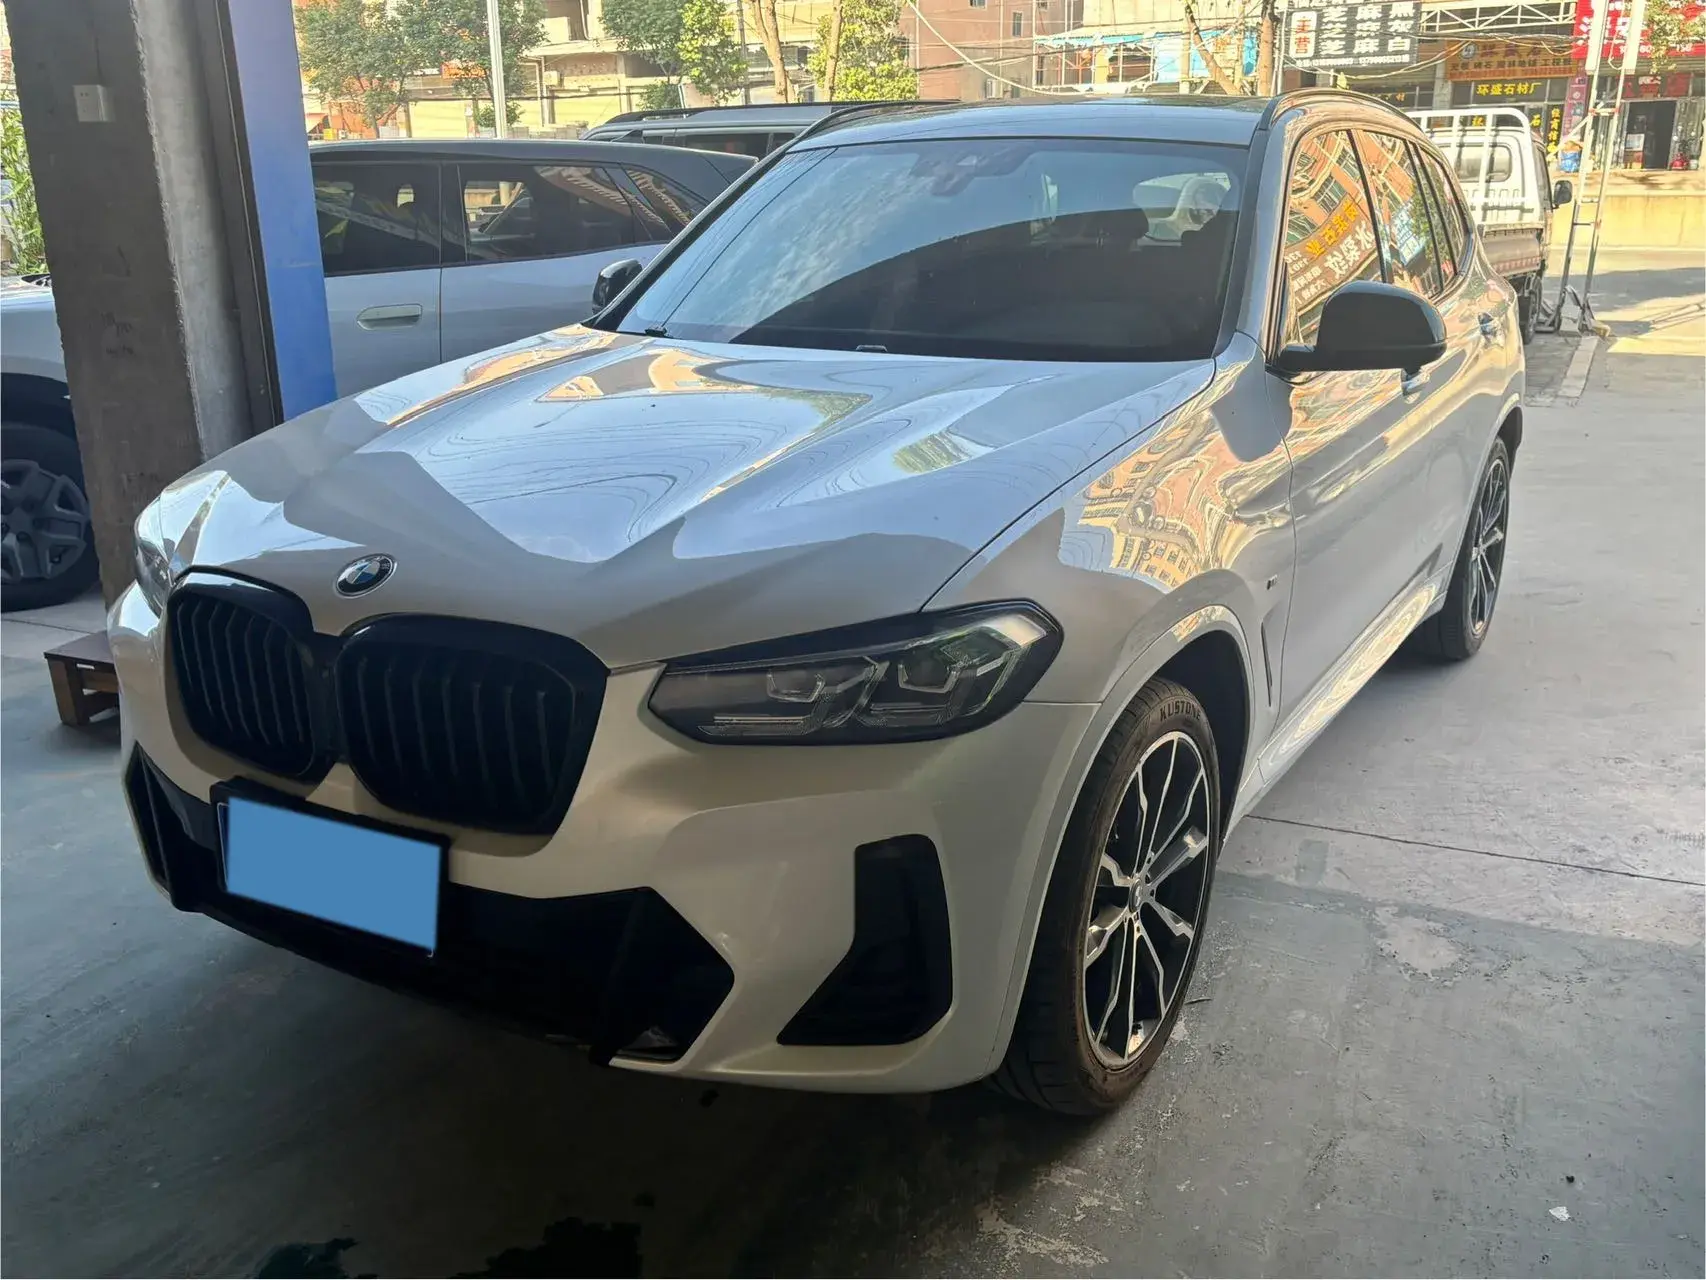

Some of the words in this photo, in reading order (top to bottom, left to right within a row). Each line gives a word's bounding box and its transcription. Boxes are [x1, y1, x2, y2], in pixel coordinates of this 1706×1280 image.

[1322, 2, 1416, 22] 芝麻黑
[1295, 16, 1310, 54] 主营
[1320, 37, 1411, 55] 芝麻白
[1477, 82, 1542, 96] 环盛石材厂
